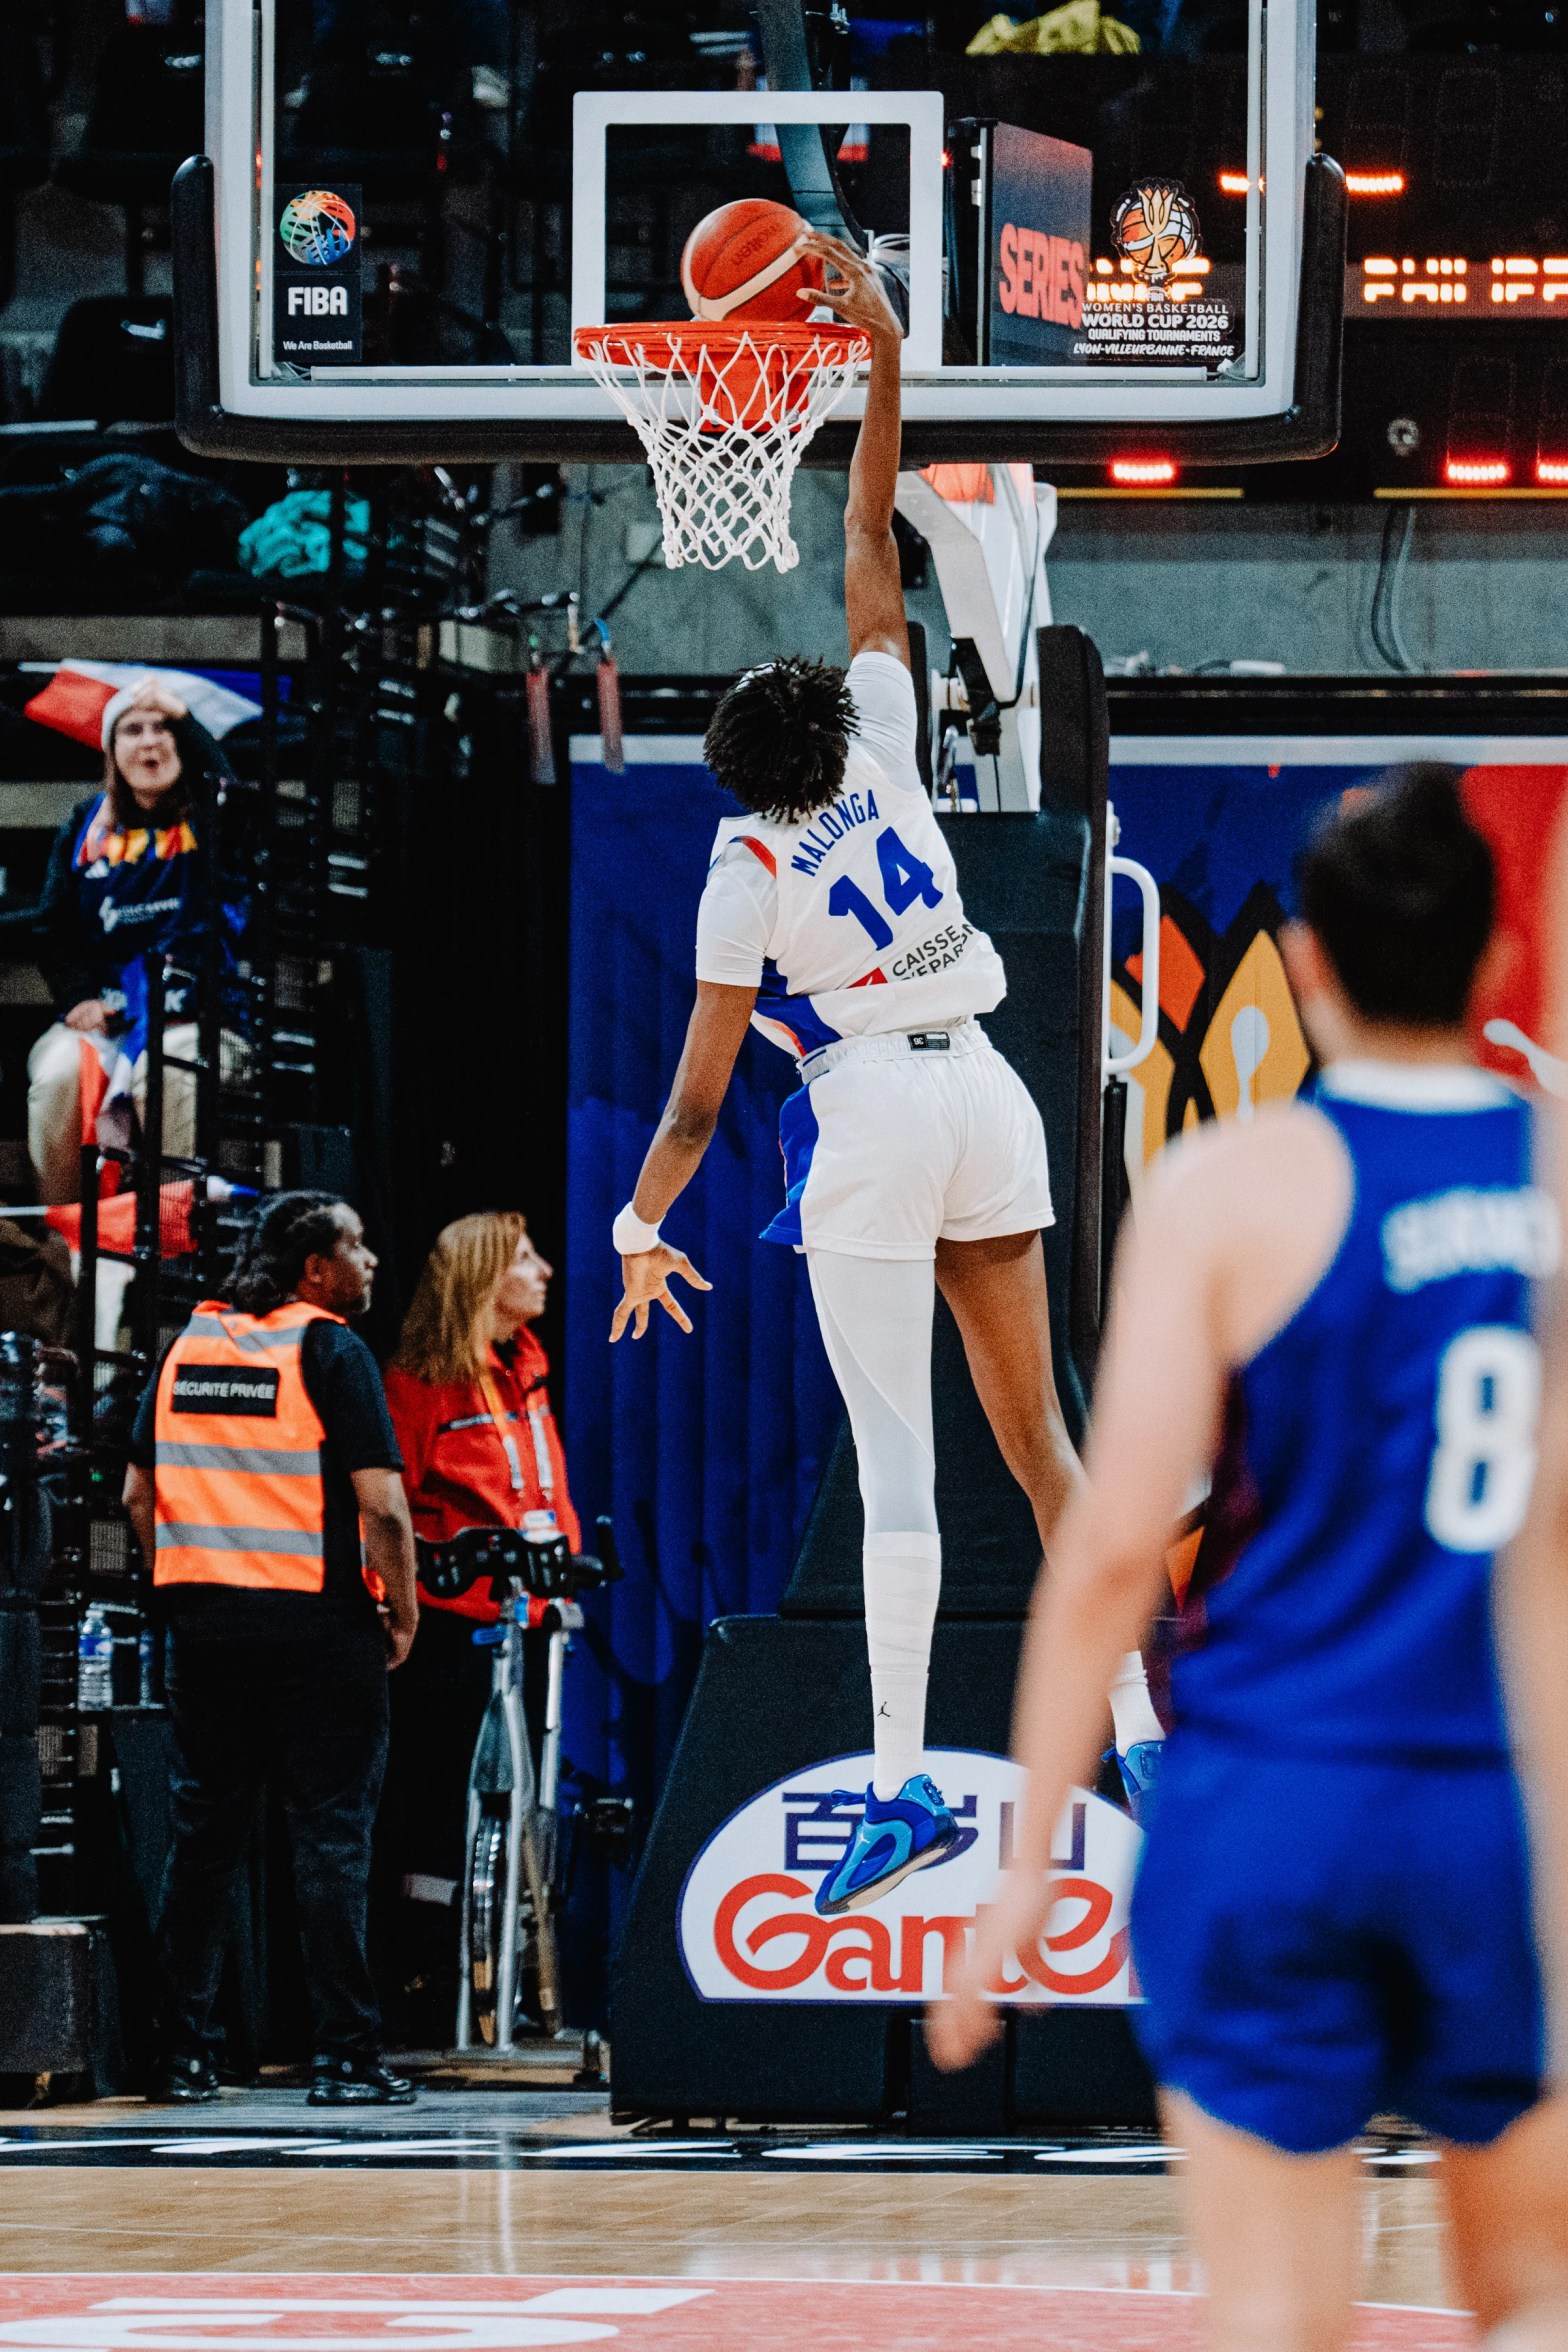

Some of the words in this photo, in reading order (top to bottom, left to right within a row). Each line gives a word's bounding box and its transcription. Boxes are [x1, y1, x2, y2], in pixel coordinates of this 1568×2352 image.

[998, 223, 1085, 330] SERIES
[288, 286, 348, 316] FIBA
[1081, 303, 1143, 313] WOMEN'S
[1147, 303, 1229, 314] BASKETBALL
[1081, 313, 1144, 328] WORLD
[1147, 314, 1183, 328] CUP
[1186, 315, 1229, 329] 2026
[283, 340, 297, 350] We
[298, 340, 312, 350] Are
[313, 340, 353, 350] Basketball
[1088, 328, 1148, 341] QUALIFYING
[1148, 329, 1220, 342] TOURNAMENTS
[790, 789, 880, 877] MALONGA
[828, 826, 944, 951] 14
[892, 924, 961, 976] CAISSE
[1424, 1322, 1541, 1553] 8
